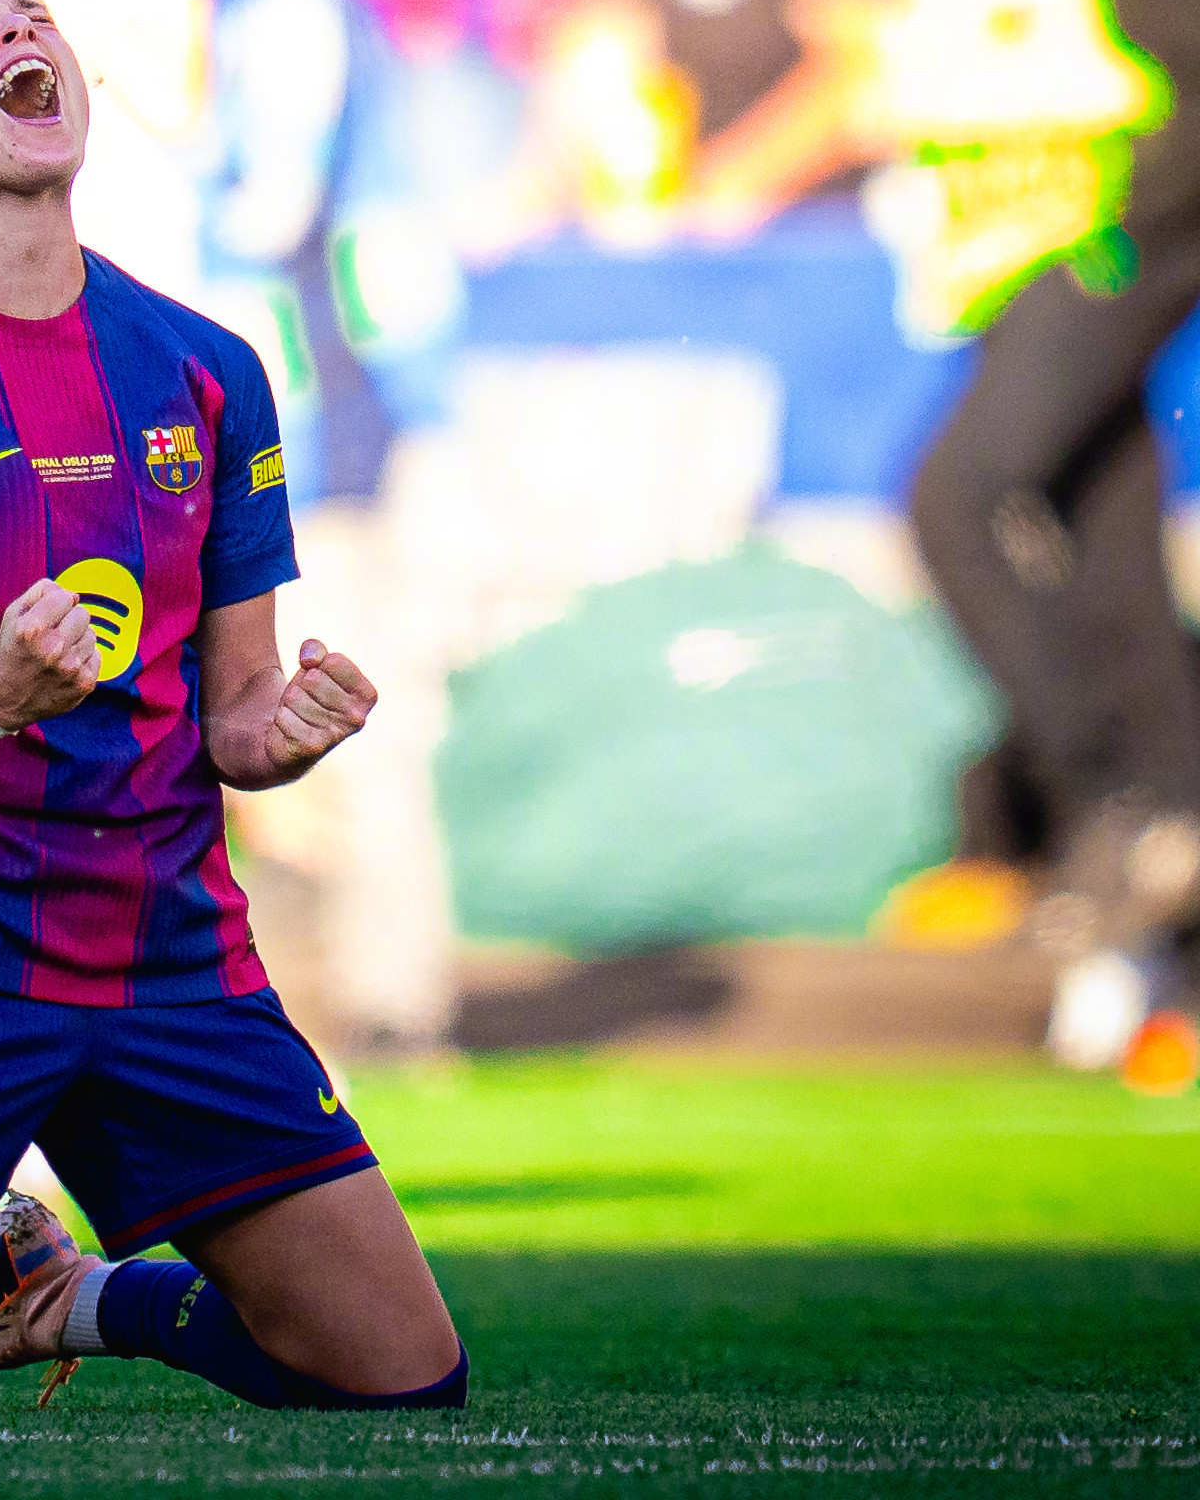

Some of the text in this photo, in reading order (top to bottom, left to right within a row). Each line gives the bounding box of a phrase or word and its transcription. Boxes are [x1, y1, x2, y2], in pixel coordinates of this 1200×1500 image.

[31, 454, 116, 469] FINAL OSLO 2026
